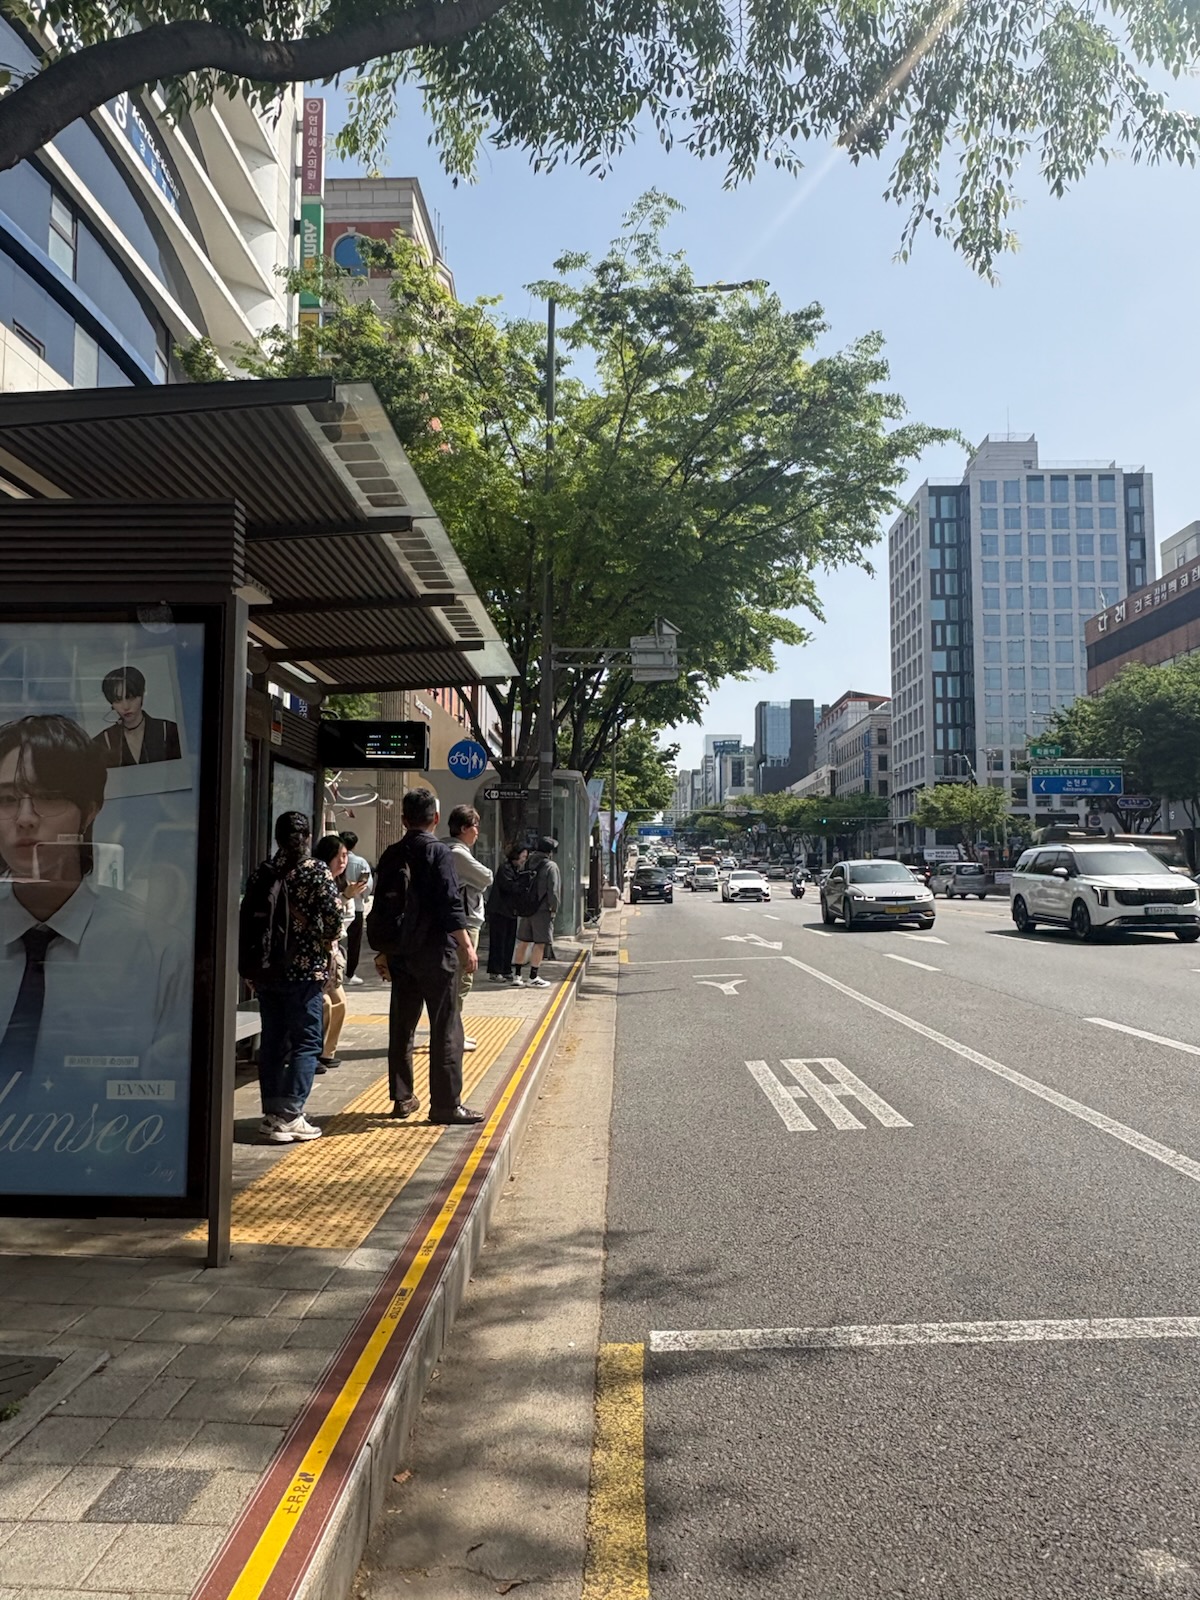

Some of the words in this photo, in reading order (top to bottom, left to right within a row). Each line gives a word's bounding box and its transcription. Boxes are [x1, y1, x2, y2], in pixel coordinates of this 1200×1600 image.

[307, 115, 318, 180] 연세에스의원
[1066, 779, 1088, 787] 논현로
[117, 1083, 166, 1096] EVNNE
[283, 1484, 311, 1514] 강남구
